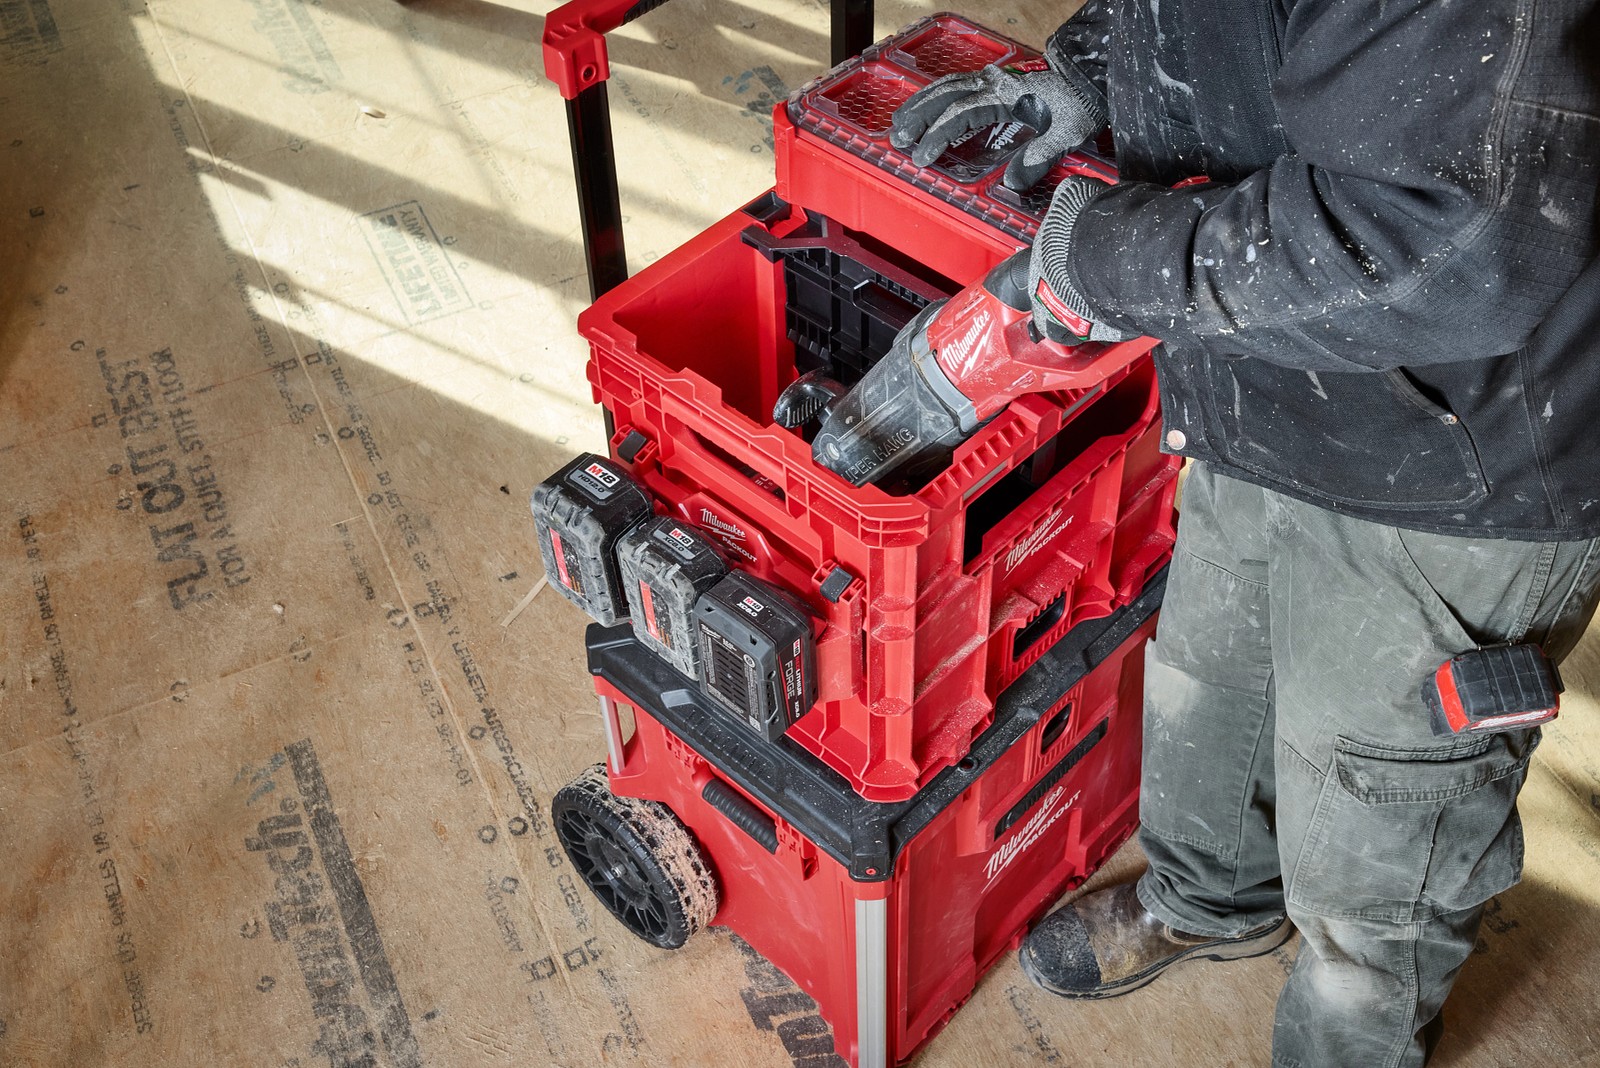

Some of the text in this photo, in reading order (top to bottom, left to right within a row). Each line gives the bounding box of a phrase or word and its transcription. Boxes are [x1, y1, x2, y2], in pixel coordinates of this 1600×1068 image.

[369, 207, 442, 320] LIFETIME
[398, 204, 461, 308] LIMITED WARRANTY
[245, 304, 262, 324] AND
[941, 309, 991, 372] Milwaukee
[147, 346, 188, 407] FLOOR
[167, 404, 206, 456] STIFF
[841, 427, 915, 484] UPER HAWG
[122, 434, 189, 518] OUT
[577, 474, 605, 493] HD12.0
[587, 464, 617, 485] M18
[207, 523, 236, 544] A
[671, 529, 691, 545] M18
[700, 507, 747, 537] Milwaukee
[1003, 508, 1062, 572] Milwaukee
[1031, 515, 1074, 556] PACKOUT
[146, 512, 218, 611] FLAT
[214, 542, 251, 589] FOR
[722, 536, 757, 562] PACKOUT
[744, 597, 762, 611] M18
[784, 660, 796, 700] FORGE
[375, 470, 392, 487] DO
[543, 844, 563, 868] NO
[582, 935, 607, 963] LA
[91, 829, 112, 854] 1/8
[982, 786, 1063, 879] Milwaukee
[1022, 789, 1081, 852] PACKOUT
[122, 968, 155, 1034] SEPARE
